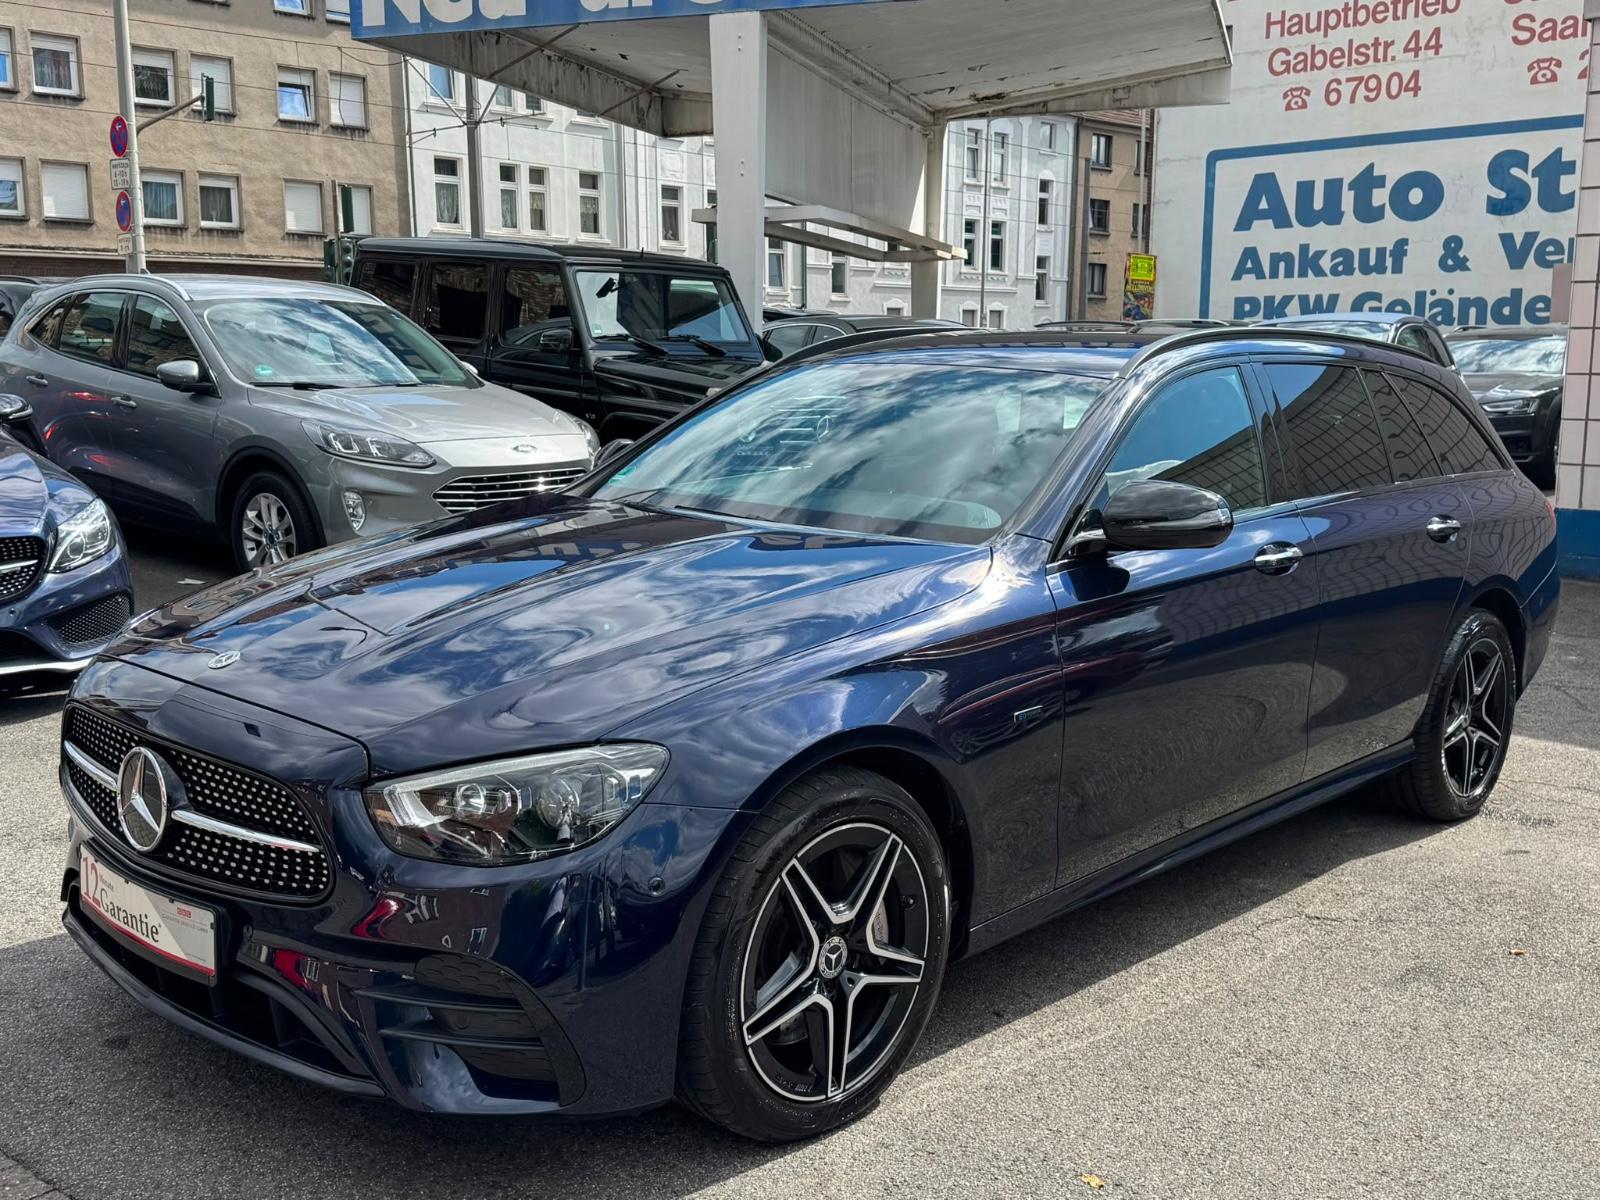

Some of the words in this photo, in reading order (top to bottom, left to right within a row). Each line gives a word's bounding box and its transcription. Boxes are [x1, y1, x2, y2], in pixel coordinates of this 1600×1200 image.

[1268, 37, 1396, 77] Gabelstr.
[1402, 26, 1443, 59] 44
[1324, 69, 1422, 107] 67904
[1233, 162, 1445, 232] Auto
[1231, 238, 1409, 281] Ankauf
[1438, 234, 1472, 273] &
[1233, 293, 1340, 320] PKW
[82, 856, 101, 908] 12
